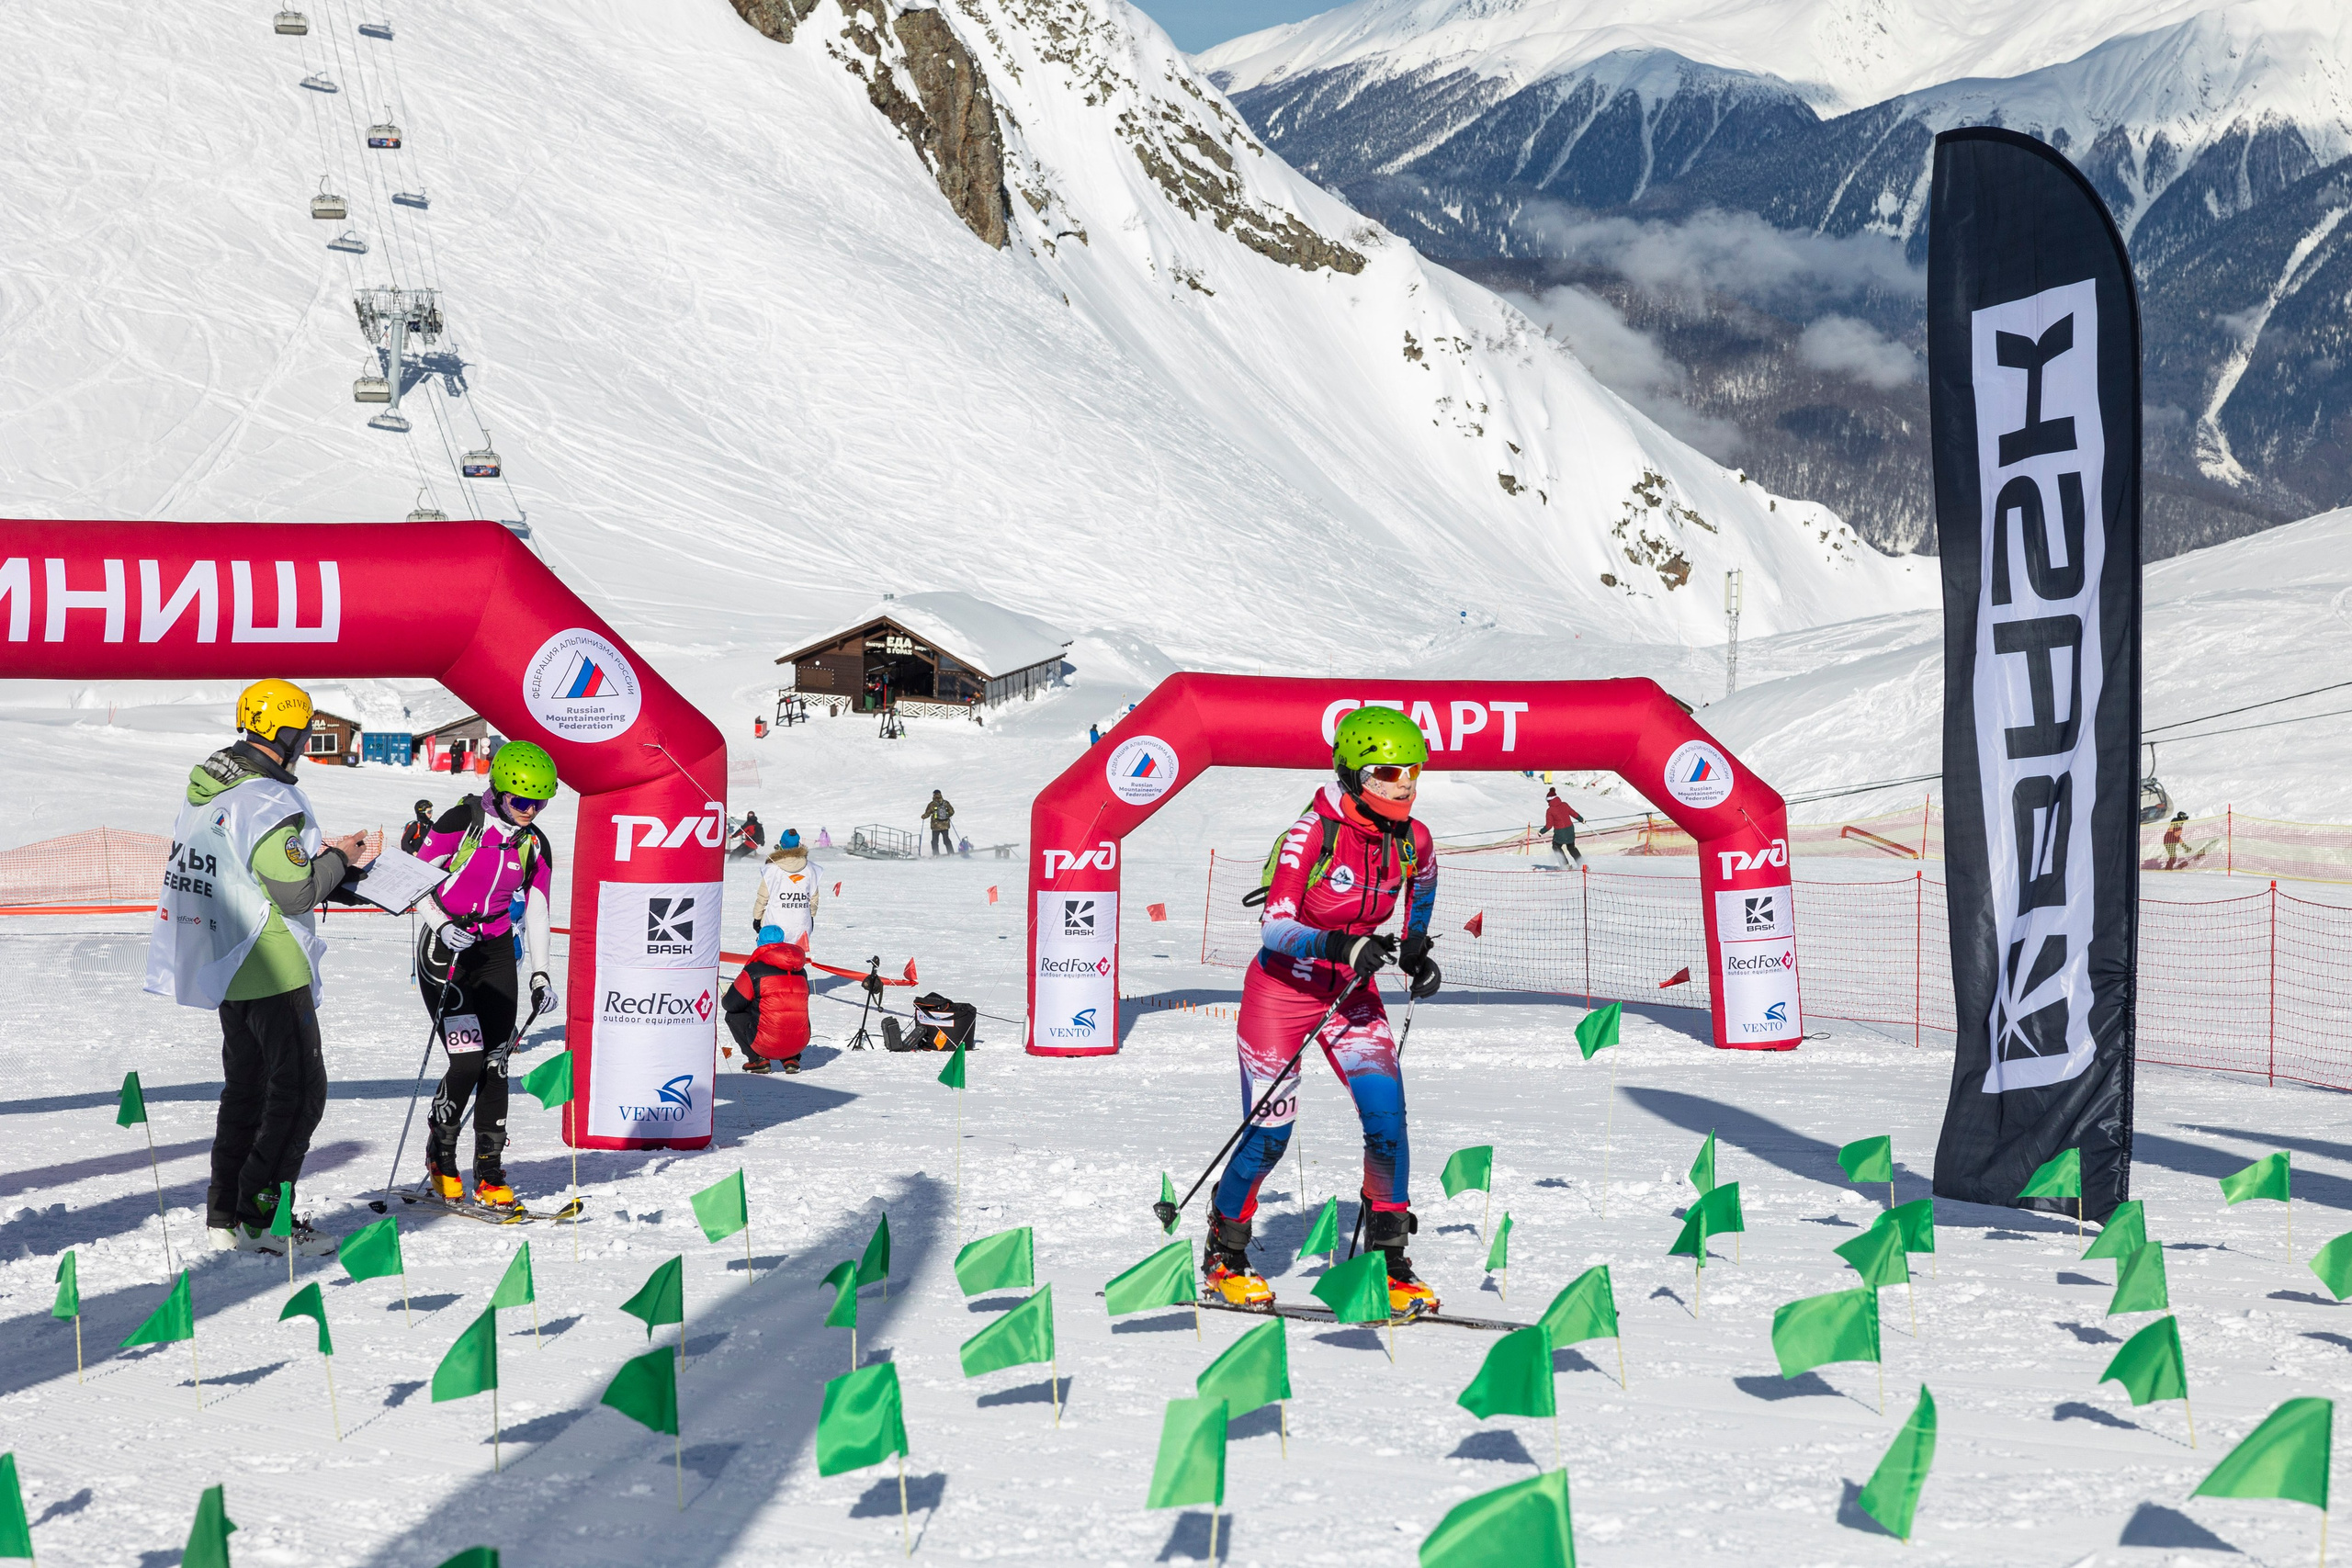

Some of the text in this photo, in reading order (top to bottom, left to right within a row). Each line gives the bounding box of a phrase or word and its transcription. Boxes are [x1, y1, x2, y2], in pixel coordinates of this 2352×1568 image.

[887, 637, 912, 649] ЕДА
[532, 637, 634, 699] ФЕДЕРАЦИЯ АЛЬПИНИЗМА РОССИИ
[567, 705, 605, 714] Russian
[546, 713, 626, 722] Mountaineering
[1747, 923, 1775, 932] BASK
[647, 945, 693, 953] BASK
[604, 1015, 695, 1025] outdoor equipment
[1049, 1028, 1090, 1037] VENTO
[1742, 1021, 1782, 1033] VENTO
[448, 1029, 481, 1046] 802
[1256, 1095, 1296, 1118] 801
[618, 1105, 684, 1122] VENTO
